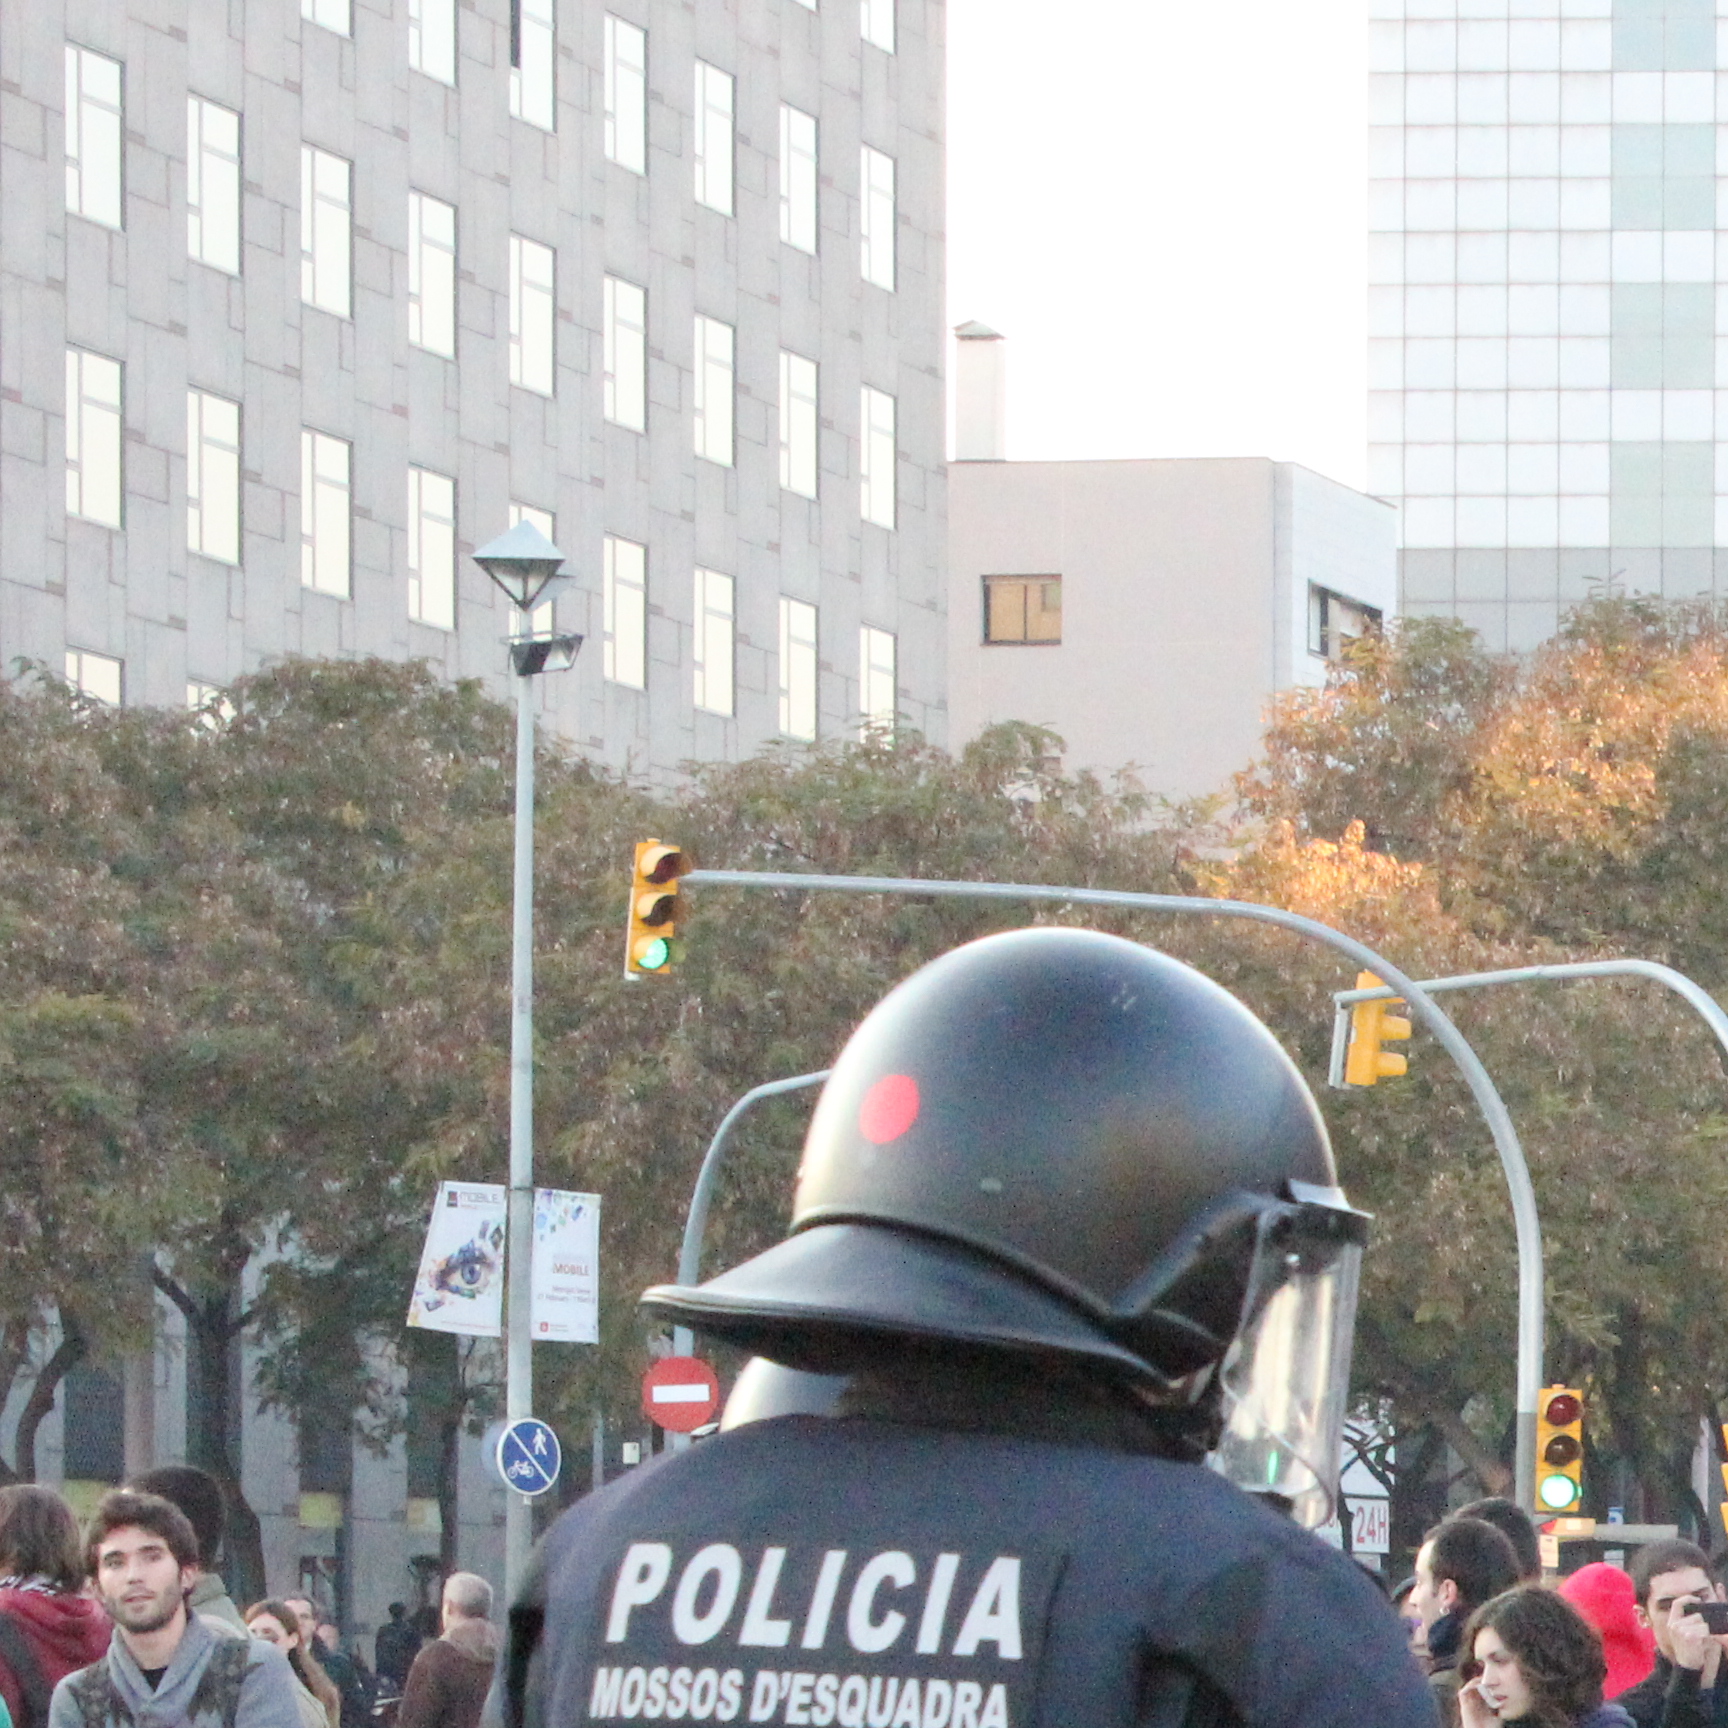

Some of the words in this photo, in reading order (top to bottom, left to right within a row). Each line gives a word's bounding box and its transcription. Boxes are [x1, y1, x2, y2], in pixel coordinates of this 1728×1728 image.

[553, 1263, 590, 1276] MOBILE
[1354, 1505, 1388, 1544] 24H
[606, 1542, 1022, 1659] POLICIA
[590, 1667, 743, 1721] MOSSOS
